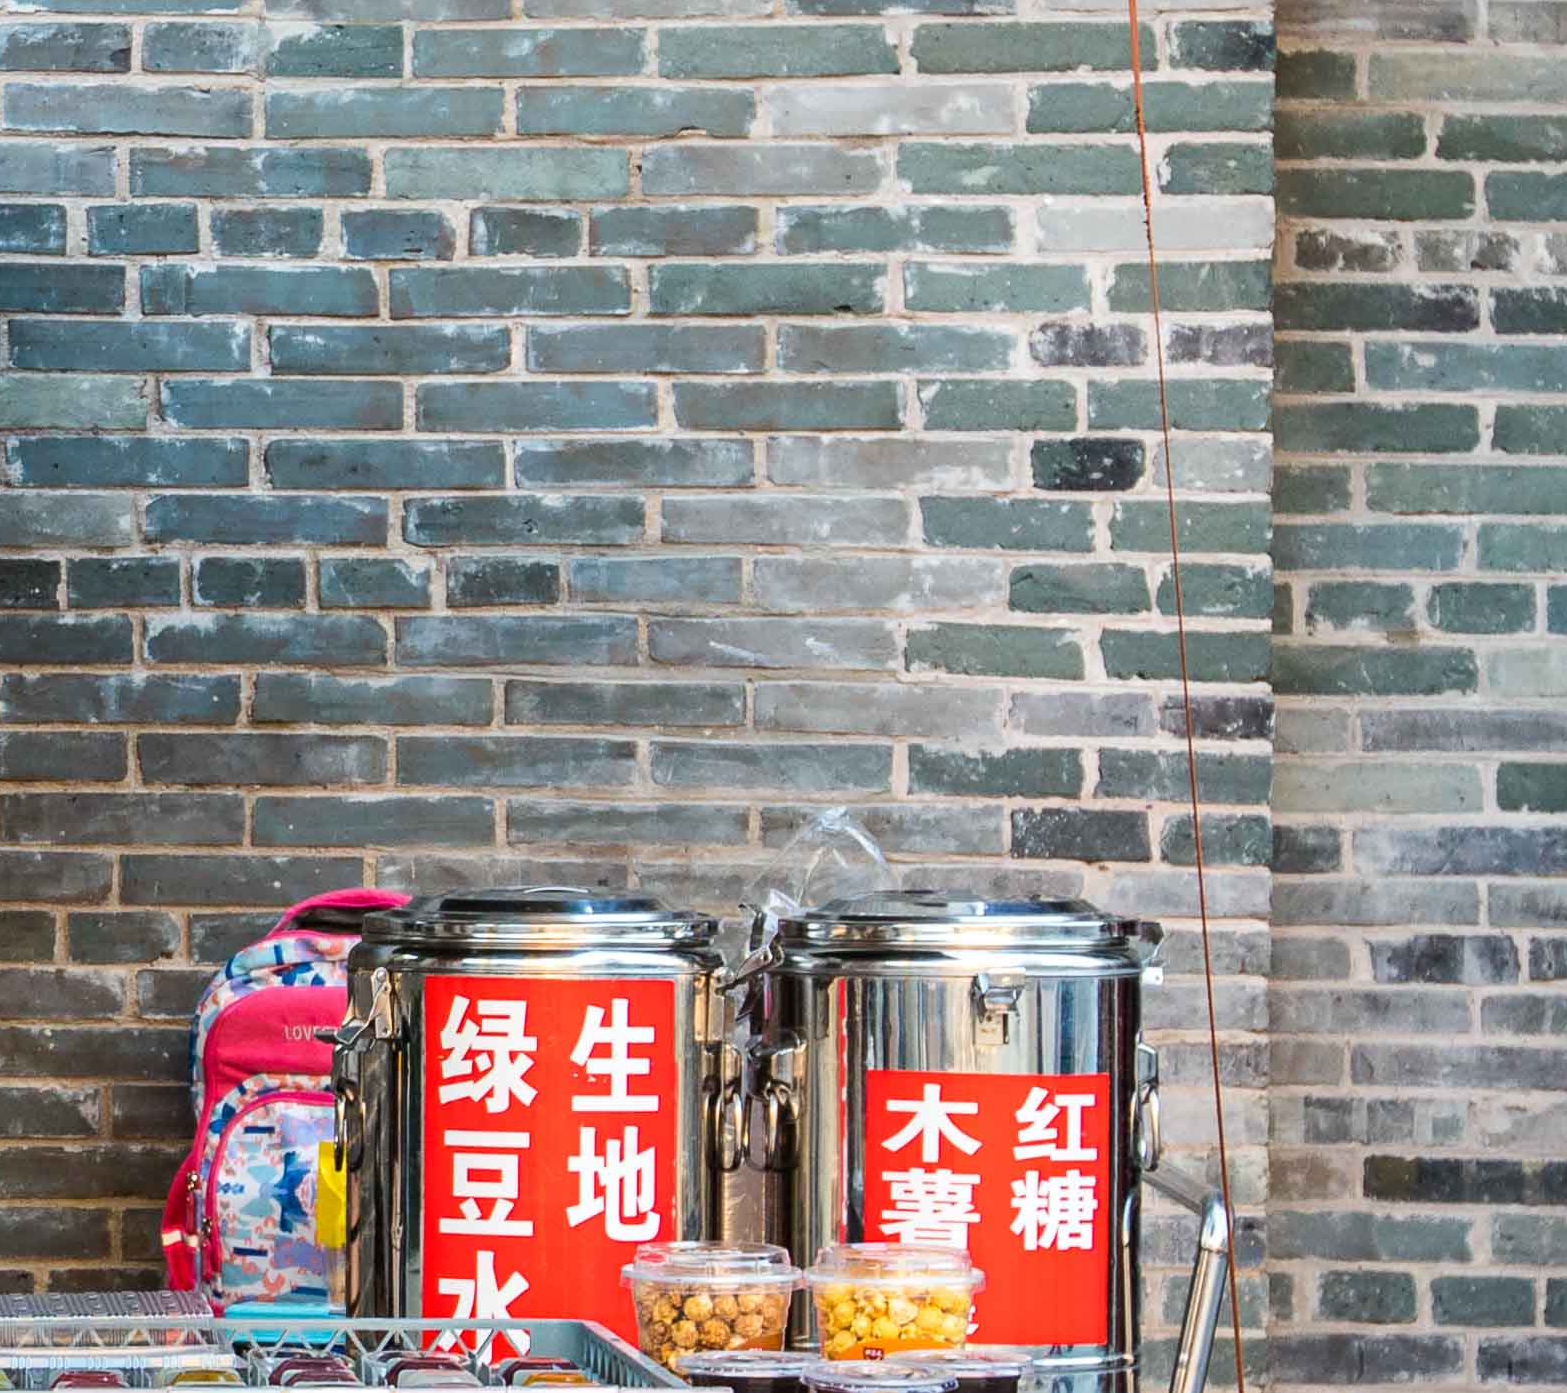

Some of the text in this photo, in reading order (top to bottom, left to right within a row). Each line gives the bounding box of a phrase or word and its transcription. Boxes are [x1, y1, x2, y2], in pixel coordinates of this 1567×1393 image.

[438, 995, 538, 1365] 绿豆水
[566, 998, 662, 1242] 生地
[880, 1083, 982, 1336] 木薯
[1010, 1086, 1098, 1250] 红糖
